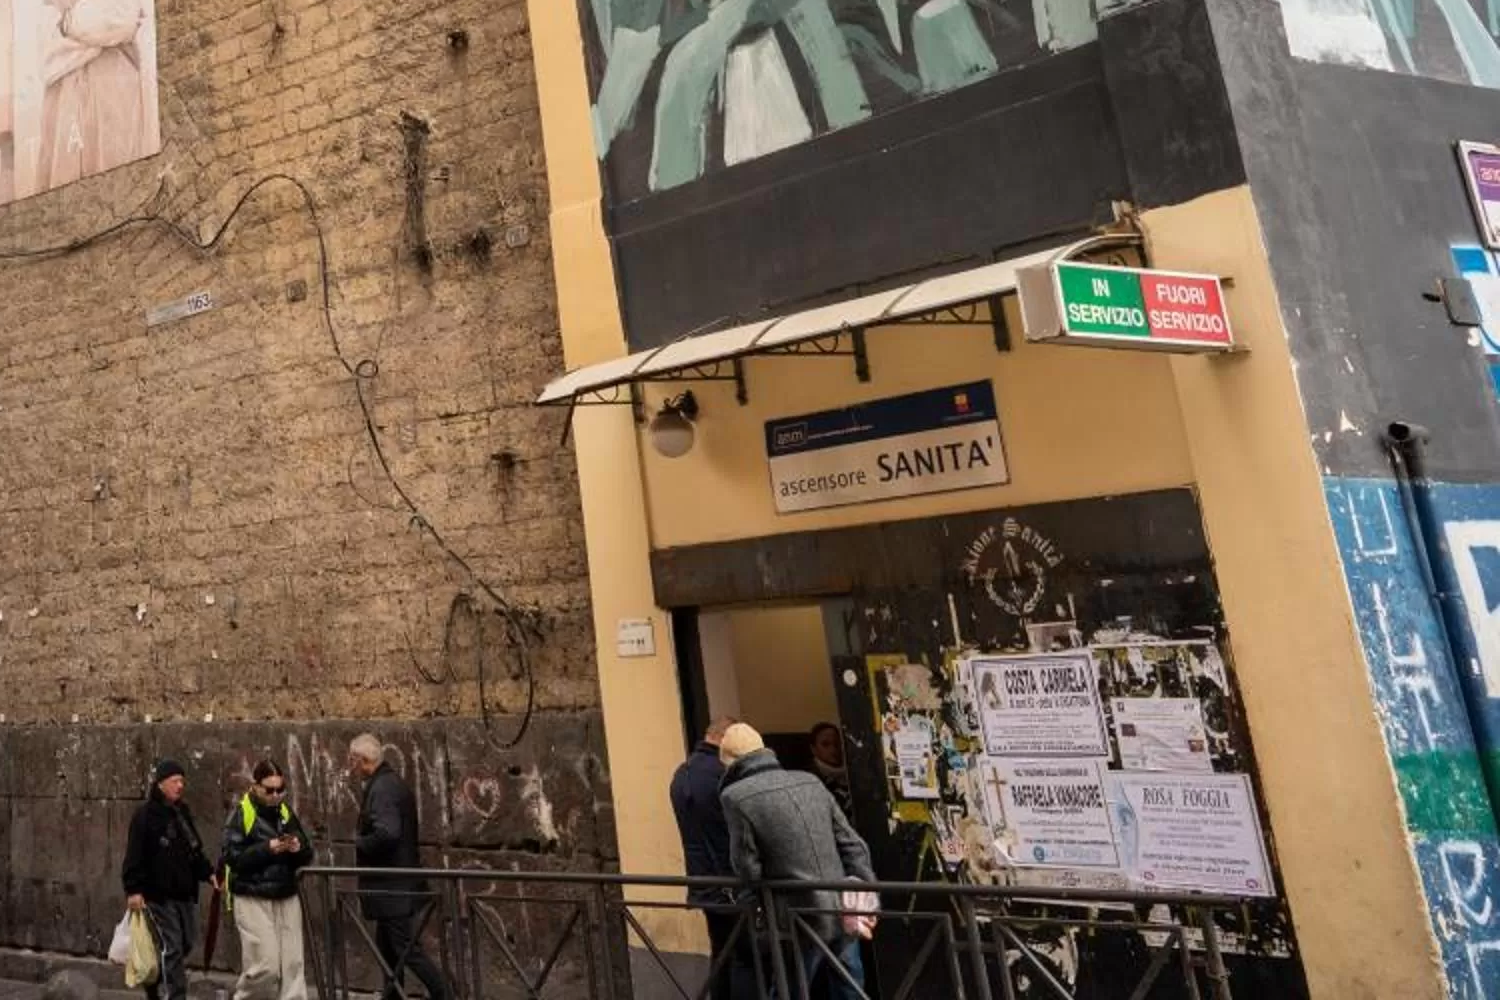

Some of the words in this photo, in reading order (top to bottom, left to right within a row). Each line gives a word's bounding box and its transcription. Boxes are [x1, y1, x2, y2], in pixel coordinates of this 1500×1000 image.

[1092, 278, 1111, 298] IN
[1156, 283, 1206, 305] FUORI
[1068, 303, 1145, 327] SERVIZIO
[1150, 309, 1224, 333] SERVIZIO
[779, 469, 867, 497] ascensore
[877, 436, 994, 482] SANITA'
[1004, 669, 1038, 695] COSTA
[1040, 666, 1089, 694] CARMELA
[1011, 783, 1055, 807] RAFFAELA
[1055, 783, 1103, 808] VANACORE
[1142, 787, 1174, 806] ROSA
[1182, 788, 1231, 809] FOGGIA
